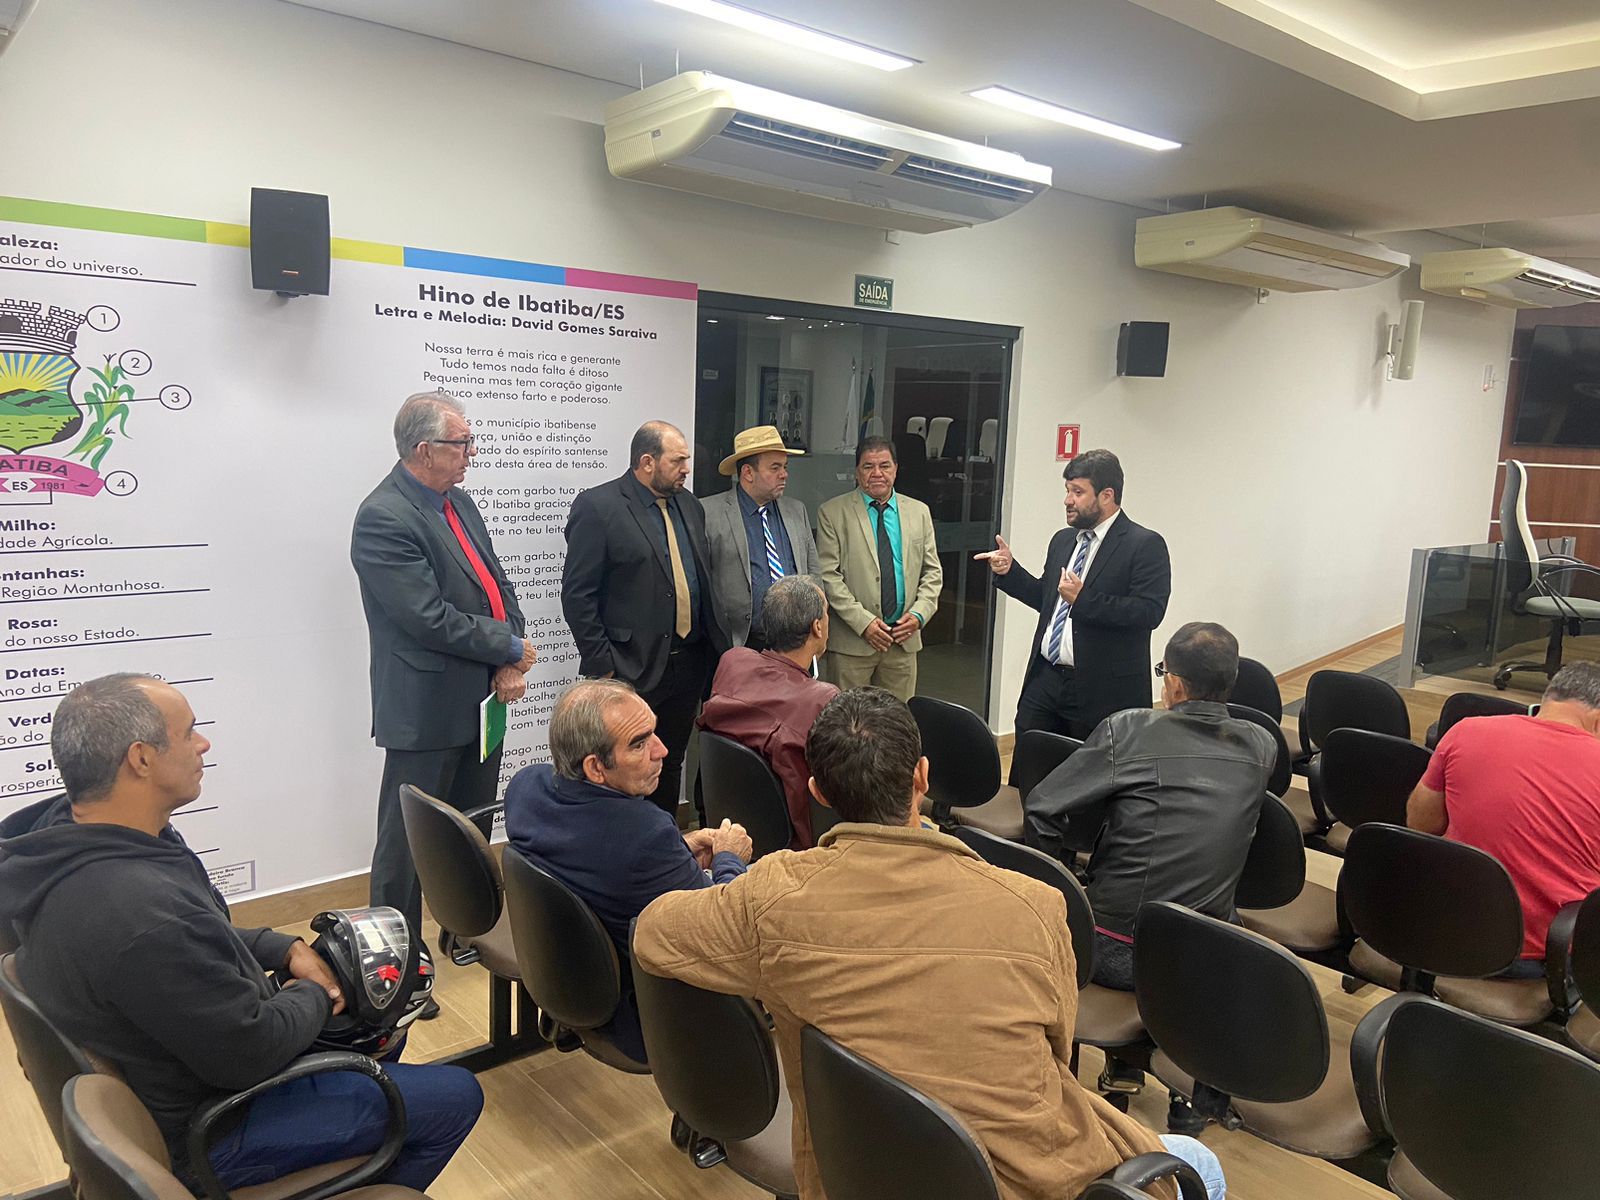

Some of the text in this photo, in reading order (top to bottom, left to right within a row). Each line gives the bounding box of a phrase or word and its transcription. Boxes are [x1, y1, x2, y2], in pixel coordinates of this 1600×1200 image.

[45, 256, 66, 269] do
[73, 260, 143, 276] universo.
[859, 281, 888, 300] SAÍDA
[419, 284, 625, 320] Hino de Ibatiba/ES
[101, 313, 107, 324] 1
[375, 304, 657, 340] Letra e Melodia: David Gomes Saraiva
[425, 342, 621, 366] Nossa terra é mais rica e generante
[131, 358, 140, 369] 2
[440, 358, 609, 378] Tudo temos nada falta é ditoso
[424, 371, 623, 392] Pequenina mas tem coração gigante
[171, 392, 180, 403] 3
[476, 390, 518, 400] extenso
[522, 391, 547, 402] farto
[551, 394, 557, 402] e
[560, 394, 611, 404] poderoso.
[487, 418, 541, 430] município
[544, 420, 597, 430] ibatibense
[501, 432, 532, 442] união
[536, 434, 542, 442] e
[545, 433, 592, 444] distinção
[505, 445, 520, 455] do
[522, 446, 561, 457] espírito
[564, 448, 609, 457] santense
[495, 459, 524, 469] desta
[528, 459, 552, 469] área
[555, 459, 569, 469] de
[572, 460, 608, 470] tensão.
[12, 481, 65, 490] ES 1981
[117, 478, 126, 489] 4
[496, 488, 520, 496] com
[524, 485, 556, 498] garbo
[477, 497, 489, 509] Ó
[492, 499, 531, 509] Ibatiba
[492, 515, 499, 523] e
[502, 511, 563, 525] agradecem
[0, 520, 56, 531] Milho:
[526, 526, 542, 535] teu
[42, 534, 113, 549] Agrícola.
[524, 550, 556, 563] garbo
[0, 567, 85, 581] ntanhas:
[2, 580, 165, 599] Região Montanhosa.
[526, 591, 542, 600] teu
[8, 619, 58, 629] Rosa:
[555, 614, 562, 624] é
[5, 627, 140, 647] do nosso Estado.
[531, 629, 546, 639] do
[6, 667, 65, 680] Datas:
[31, 681, 52, 694] da
[522, 691, 556, 703] acolhe
[511, 721, 534, 730] com
[23, 730, 44, 742] do
